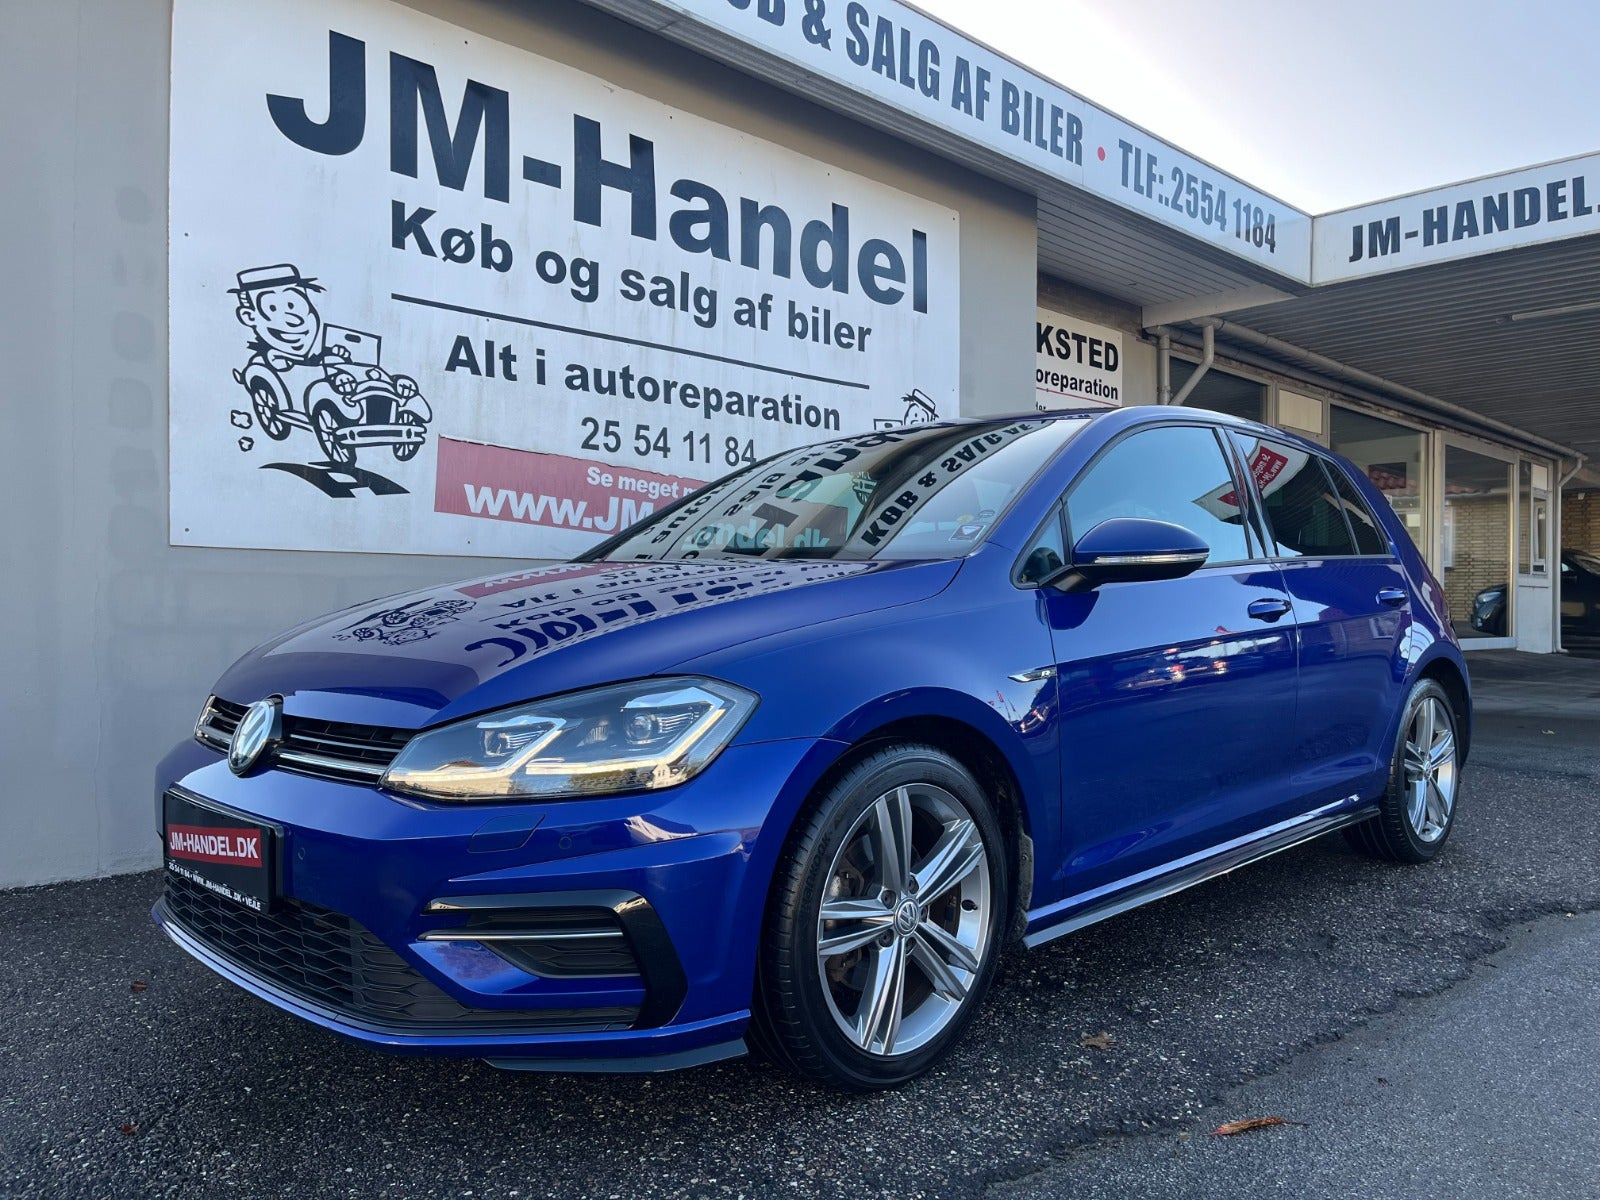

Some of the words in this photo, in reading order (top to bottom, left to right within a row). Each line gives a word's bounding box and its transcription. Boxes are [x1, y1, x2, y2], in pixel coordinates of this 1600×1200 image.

[266, 29, 928, 315] JM-Handel
[846, 2, 940, 101] SALG
[951, 56, 991, 122] AF
[1001, 79, 1083, 166] BILER
[1233, 198, 1276, 254] 1184
[1348, 176, 1600, 263] JM-HANDEL
[391, 200, 513, 273] Køb
[535, 250, 600, 303] og
[620, 268, 718, 328] salg
[733, 293, 773, 331] af
[788, 300, 872, 352] biler
[444, 335, 517, 381] Alt
[535, 349, 546, 385] i
[564, 362, 841, 431] autoreparation
[581, 417, 621, 453] 25
[634, 423, 670, 459] 54
[682, 430, 712, 464] 11
[725, 437, 757, 467] 84
[587, 466, 613, 488] Se
[618, 475, 679, 499] meget
[170, 831, 259, 859] JM-HANDEL.DK
